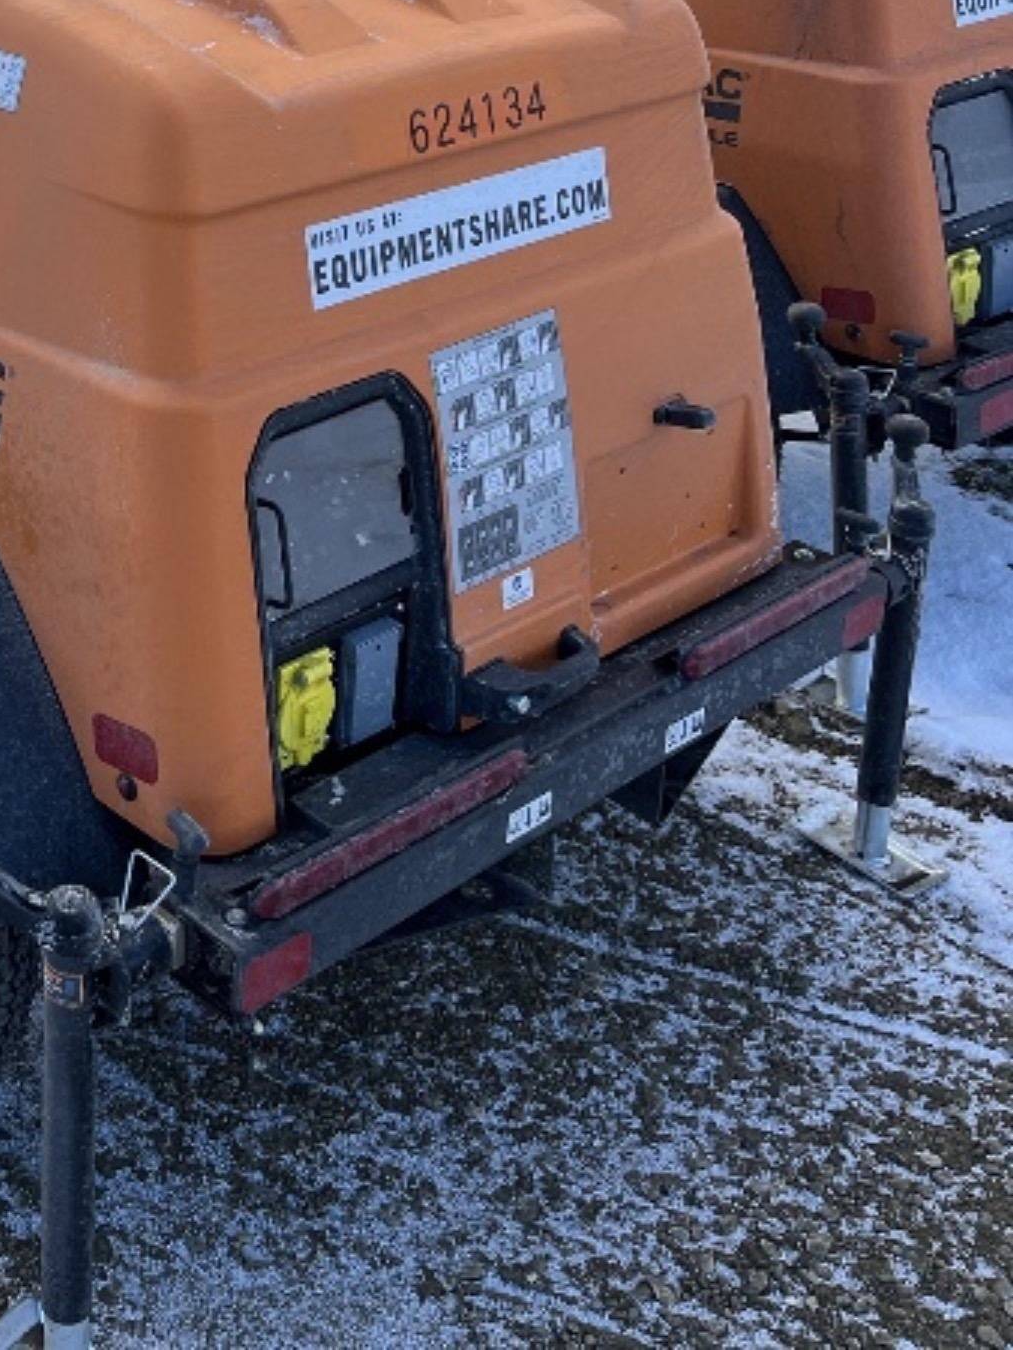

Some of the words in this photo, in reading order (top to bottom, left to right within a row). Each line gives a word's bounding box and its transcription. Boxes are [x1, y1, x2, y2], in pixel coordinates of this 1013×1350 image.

[409, 81, 547, 154] 624134
[310, 224, 349, 250] VISIT
[355, 218, 376, 238] US
[382, 211, 403, 229] AT:
[313, 176, 607, 295] EQUIPMENTSHARE.COM
